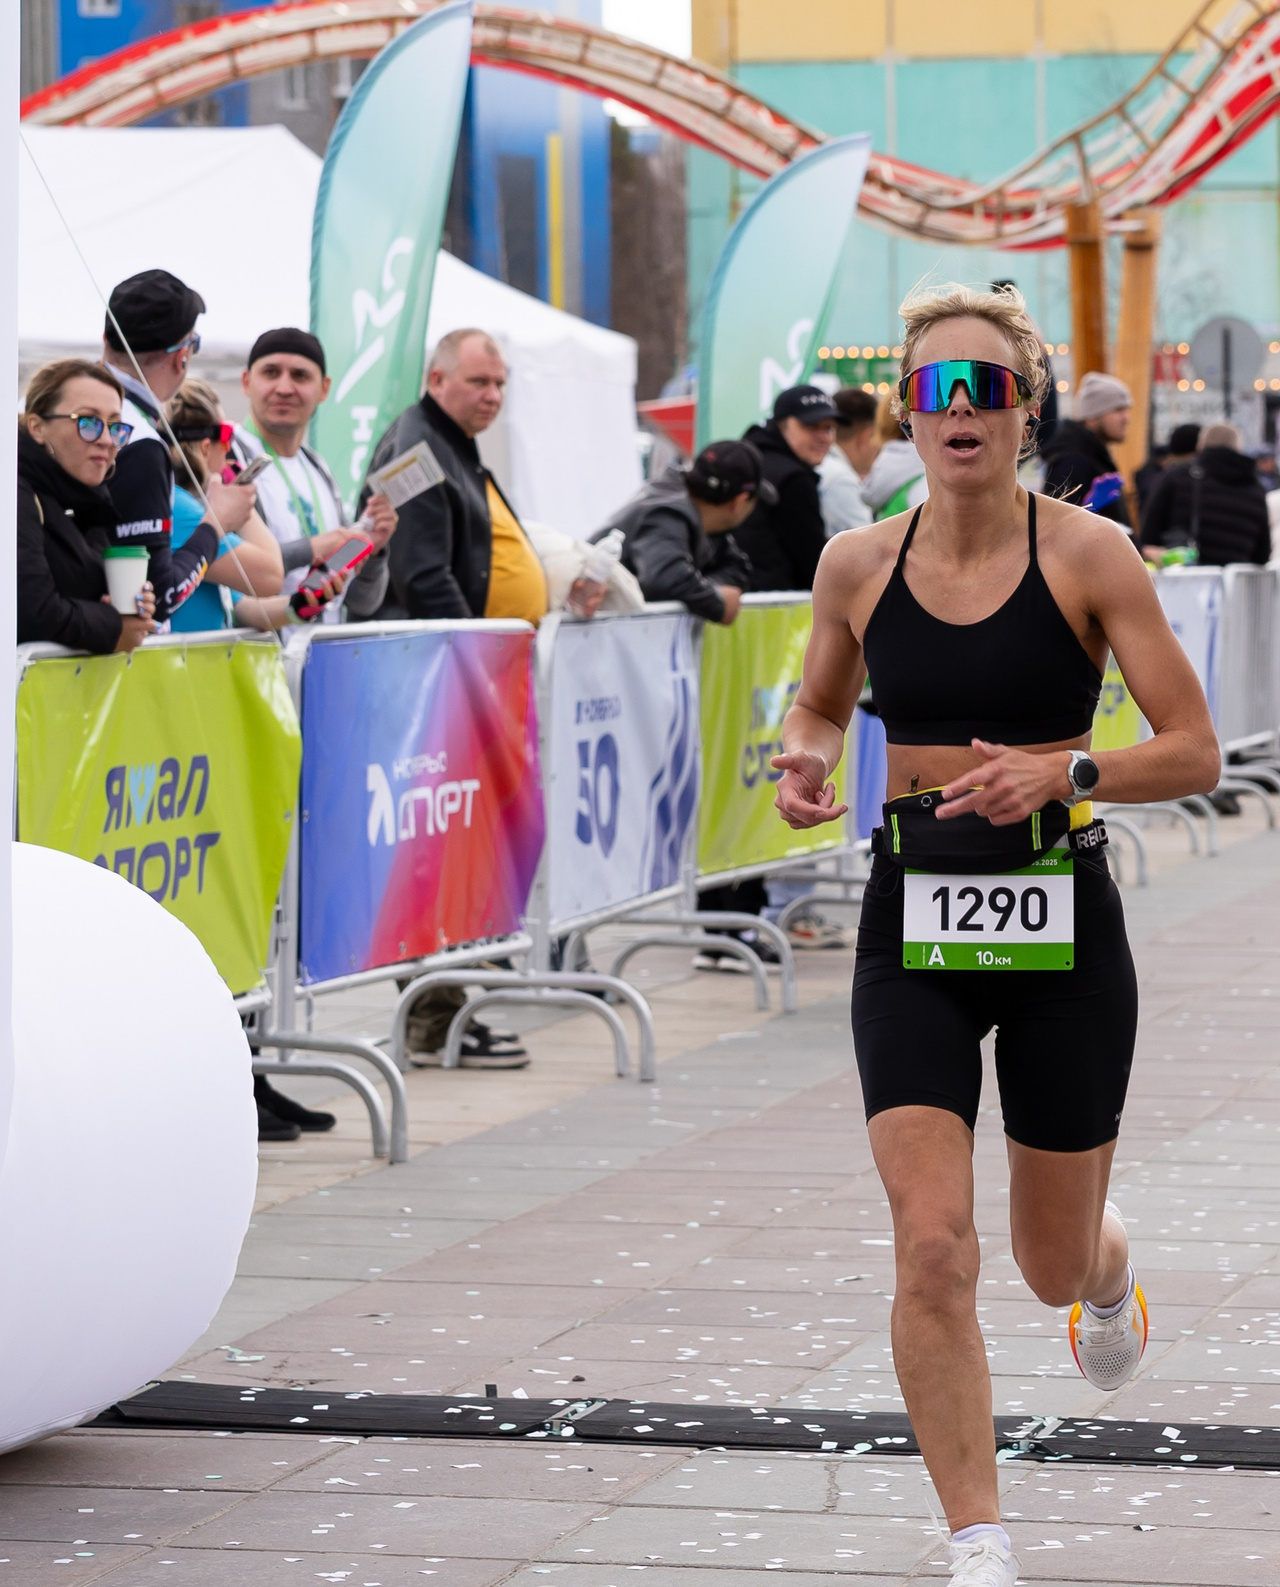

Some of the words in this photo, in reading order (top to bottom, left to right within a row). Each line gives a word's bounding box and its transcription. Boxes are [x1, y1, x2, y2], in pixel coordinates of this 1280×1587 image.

[576, 732, 619, 857] 50
[93, 831, 221, 905] ПОРТ
[932, 886, 1048, 932] 1290
